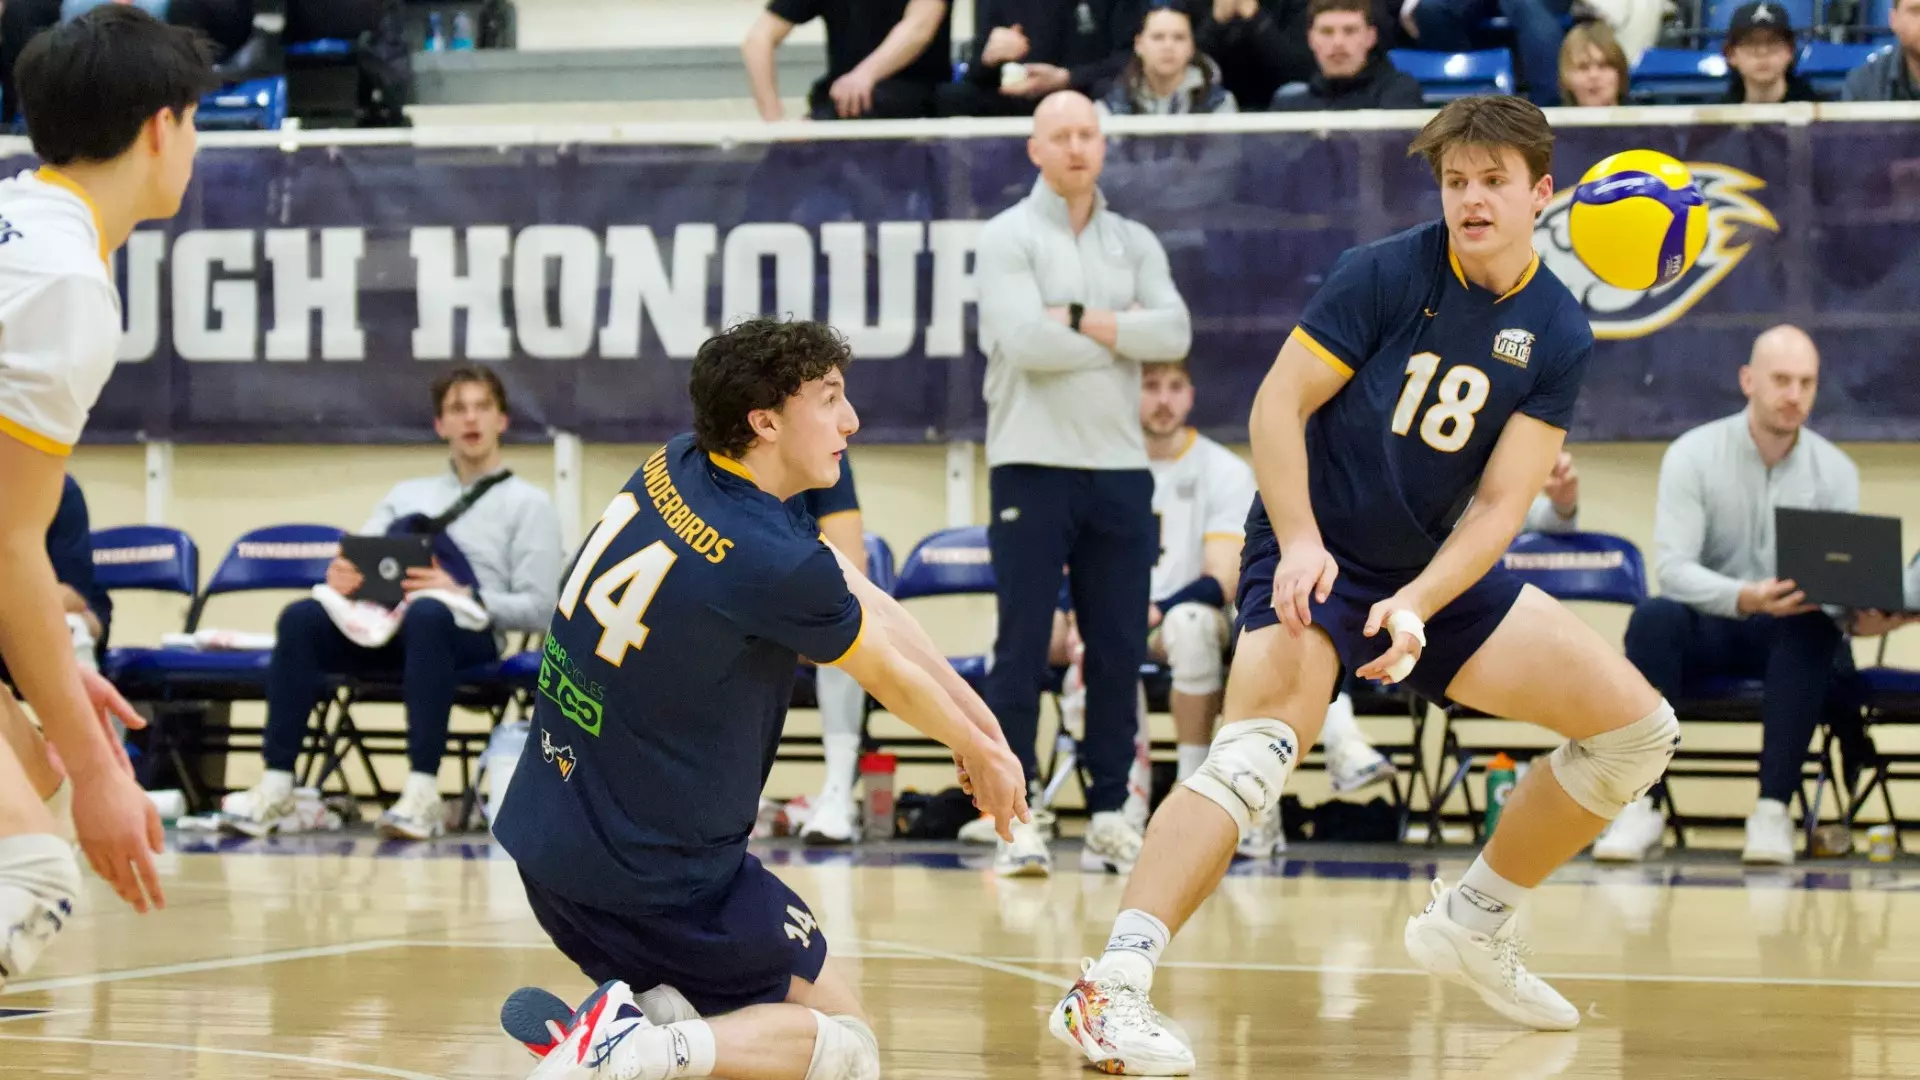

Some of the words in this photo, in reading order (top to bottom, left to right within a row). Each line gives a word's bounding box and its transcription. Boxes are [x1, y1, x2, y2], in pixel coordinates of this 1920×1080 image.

[1391, 351, 1491, 453] 18
[641, 443, 735, 565] UNDERBIRDS
[558, 491, 679, 668] 14
[783, 903, 817, 949] 14
